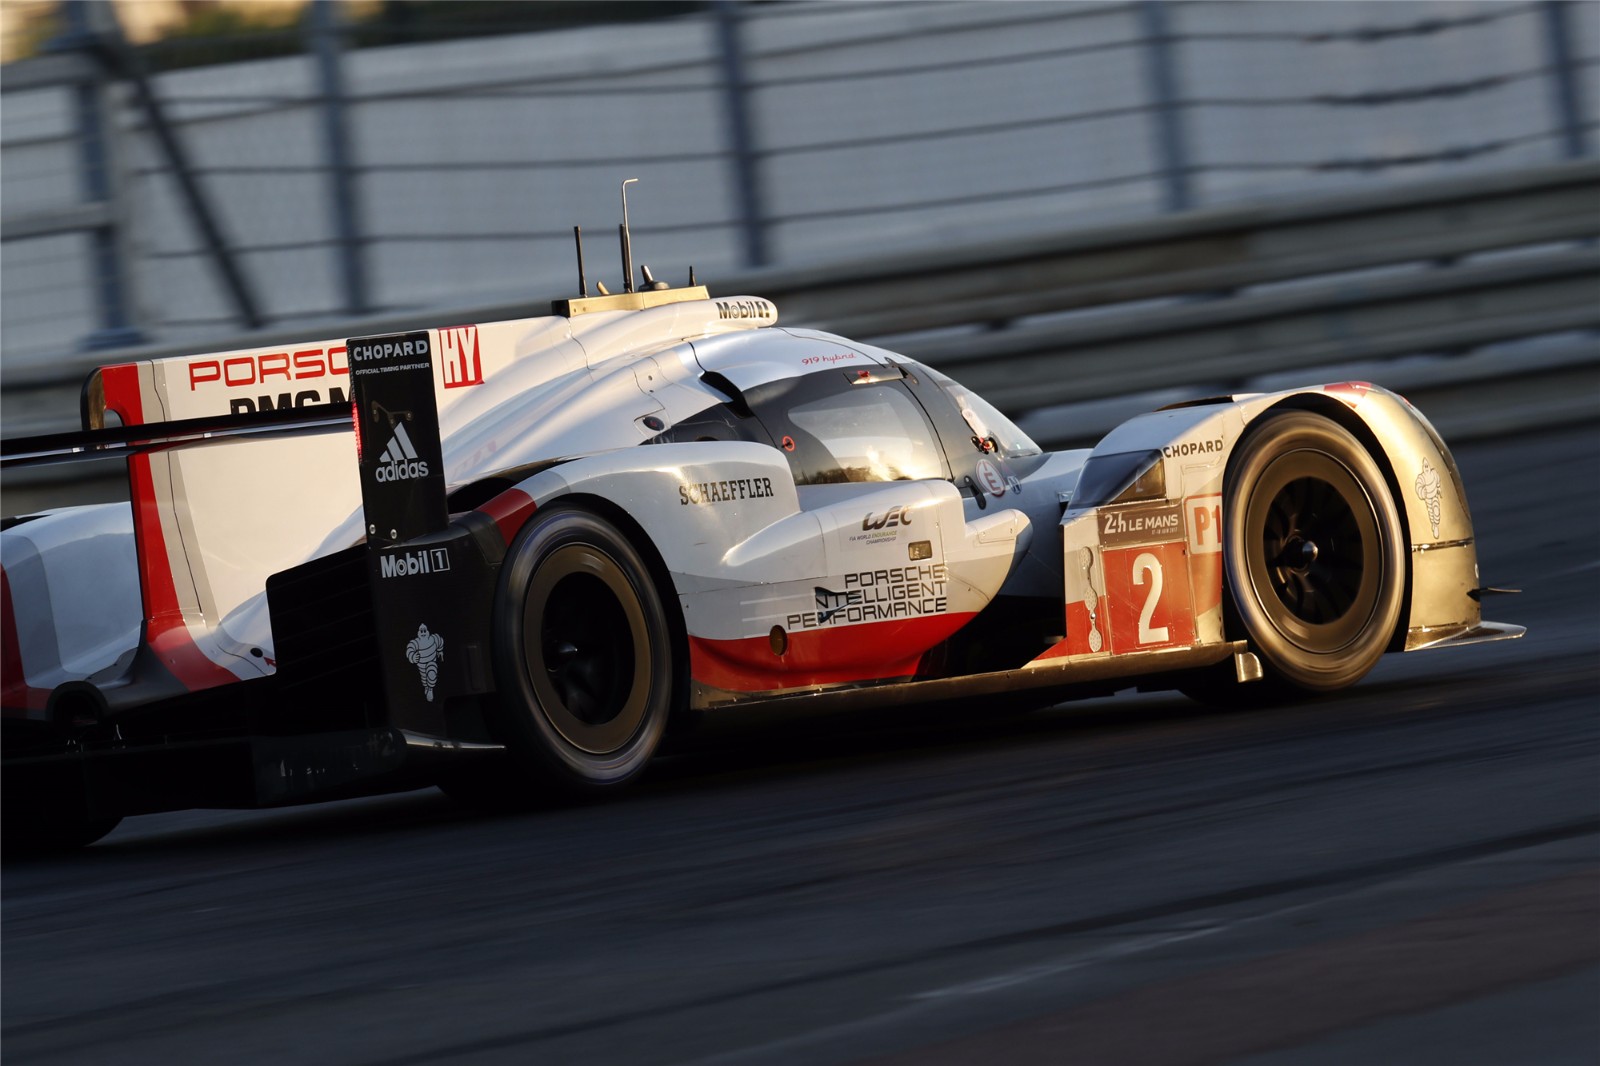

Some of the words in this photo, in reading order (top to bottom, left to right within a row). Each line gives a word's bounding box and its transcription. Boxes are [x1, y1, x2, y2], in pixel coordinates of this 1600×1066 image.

[715, 301, 755, 319] Mobil
[353, 340, 428, 361] CHOPARD
[440, 326, 477, 384] HY
[801, 356, 820, 365] 919
[822, 353, 855, 364] hybrid
[400, 362, 430, 371] PARTNER
[1162, 439, 1223, 458] CHOPARD
[375, 458, 429, 482] adidas
[679, 477, 774, 505] SCHAEFFLER
[862, 505, 912, 531] WEC
[1104, 512, 1127, 534] 24h
[1128, 518, 1143, 531] LE
[1144, 514, 1178, 530] MANS
[1193, 504, 1222, 546] P1
[380, 550, 430, 578] Mobil
[844, 563, 946, 588] PORSCHE
[1132, 552, 1169, 645] 2
